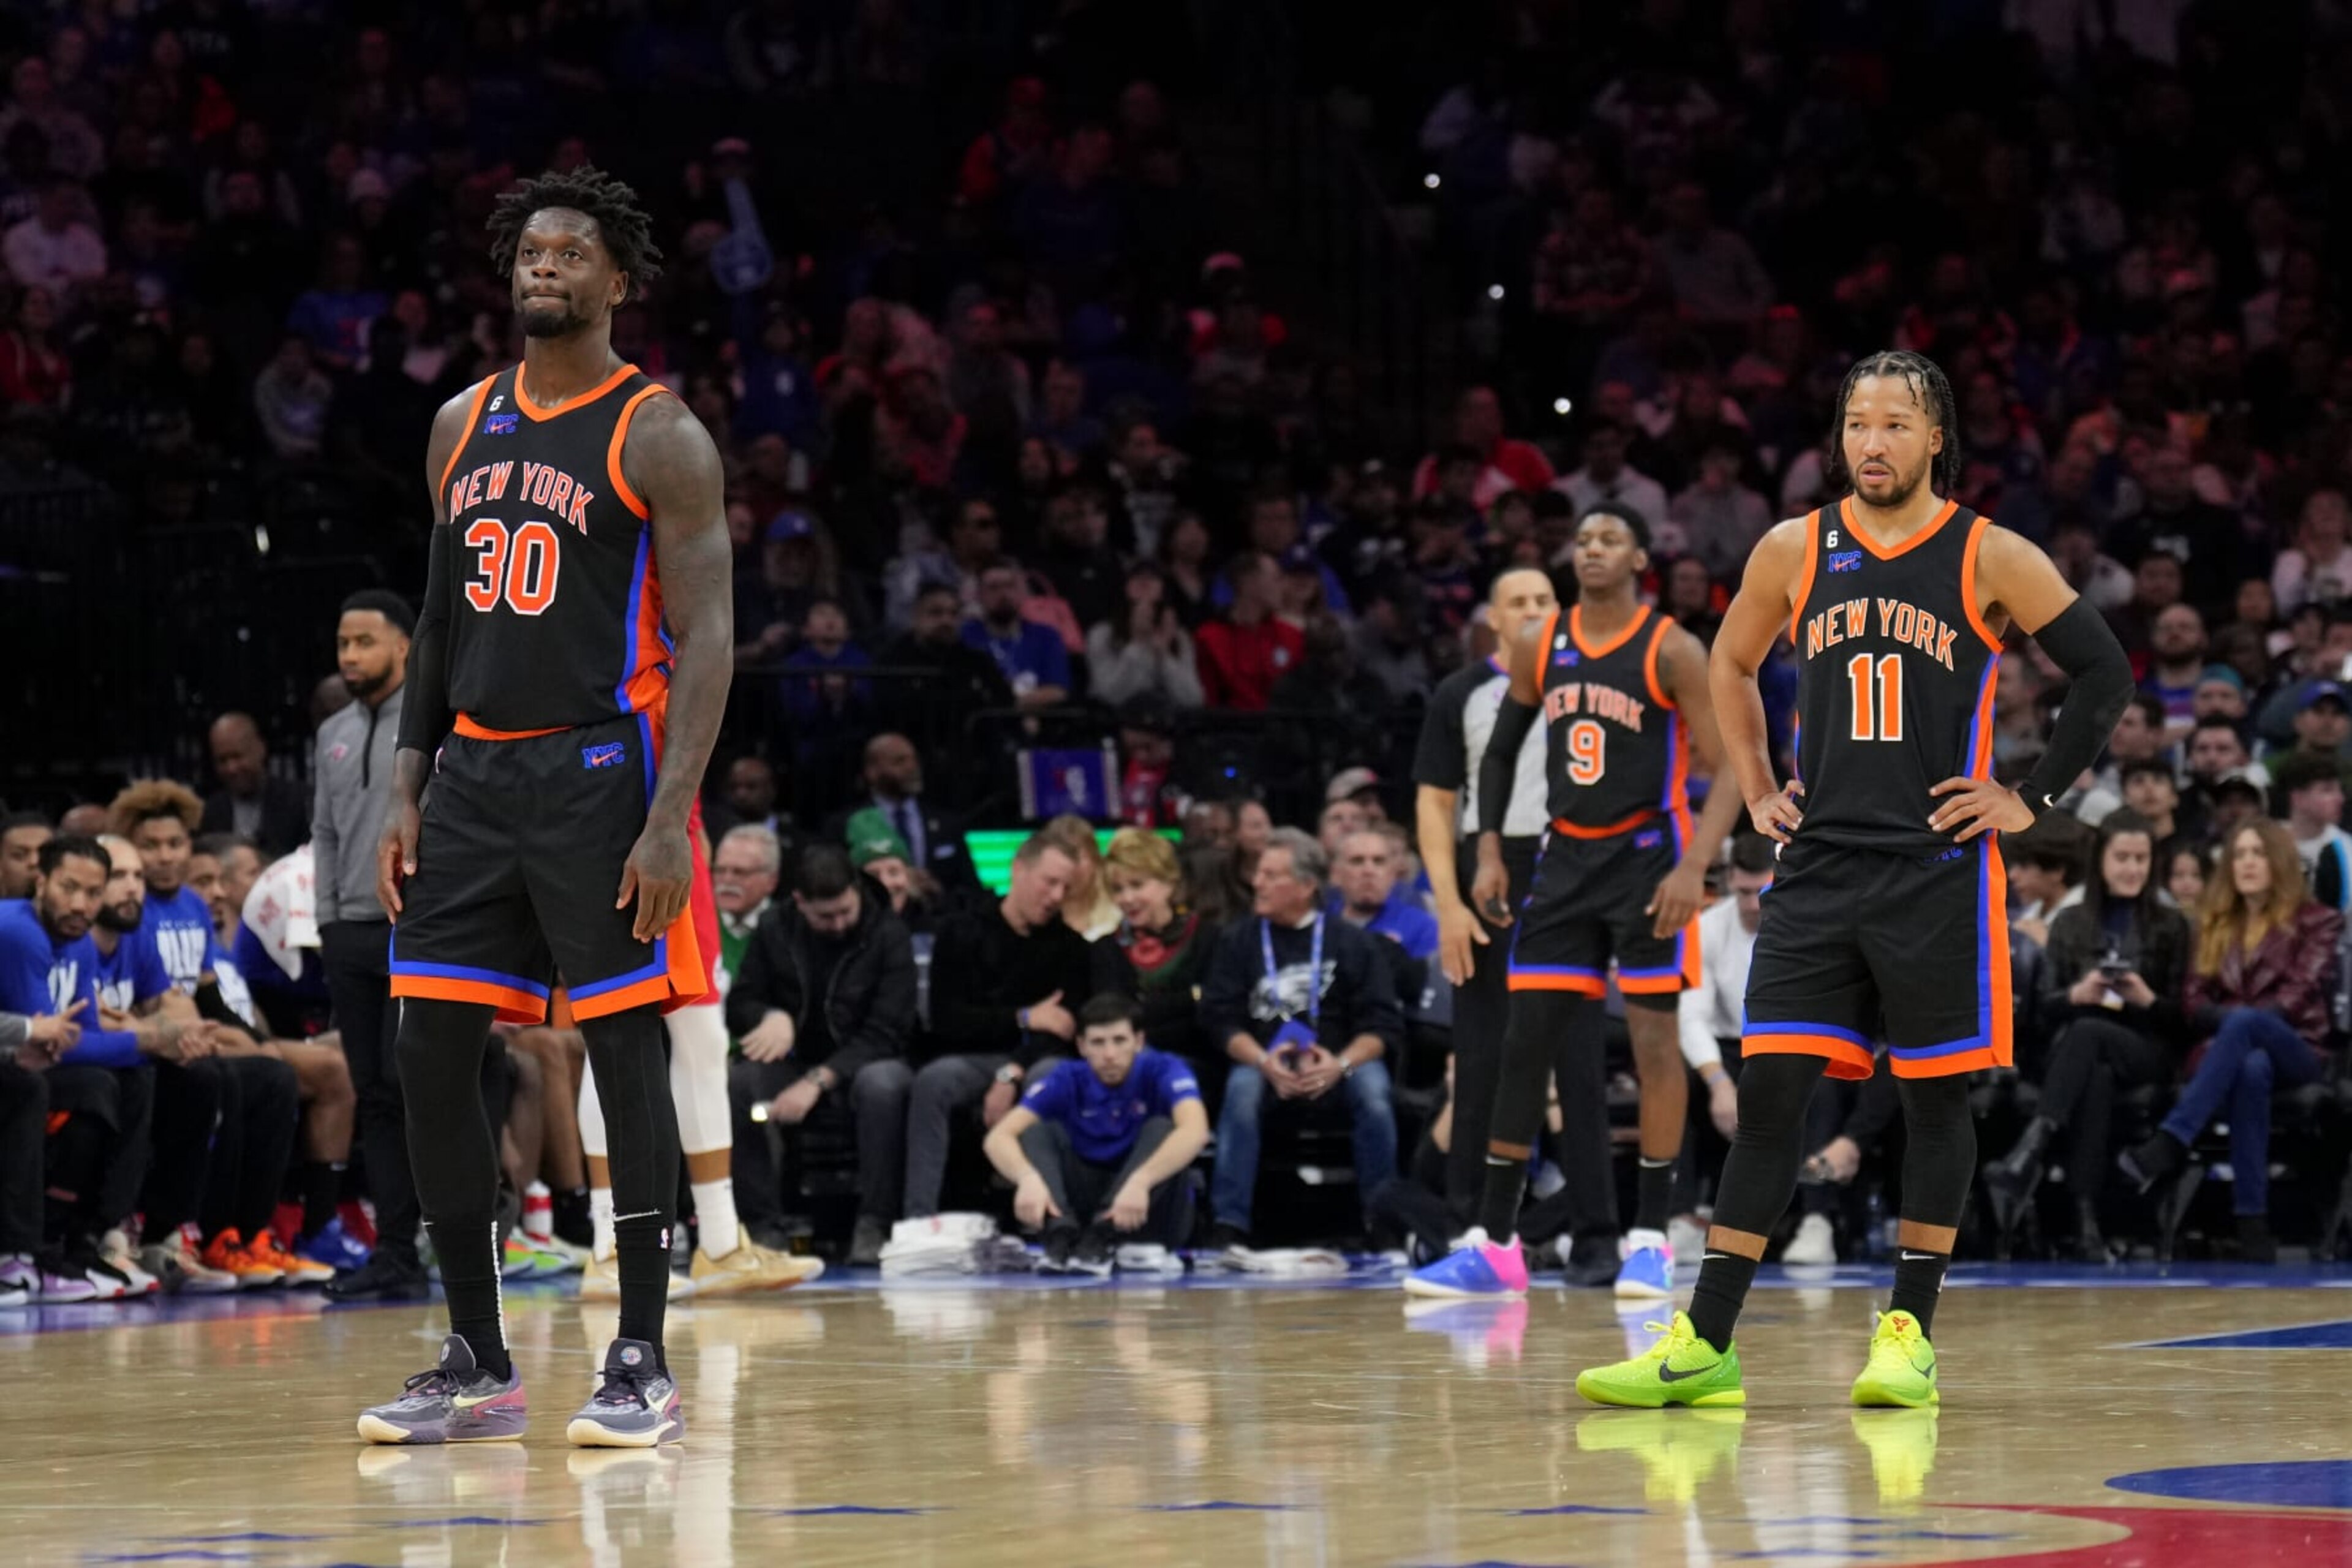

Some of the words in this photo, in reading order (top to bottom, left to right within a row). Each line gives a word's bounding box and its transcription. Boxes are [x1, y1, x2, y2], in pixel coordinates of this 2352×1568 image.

[489, 395, 504, 412] 6
[450, 461, 514, 524] NEW
[520, 461, 594, 536] YORK
[465, 518, 560, 615] 30
[1826, 530, 1838, 548] 6
[1807, 598, 1869, 660] NEW
[1877, 598, 1958, 672] YORK
[1544, 682, 1581, 725] NEW
[1585, 682, 1646, 733] YORK
[1848, 653, 1902, 741] 11
[1567, 719, 1605, 785] 9
